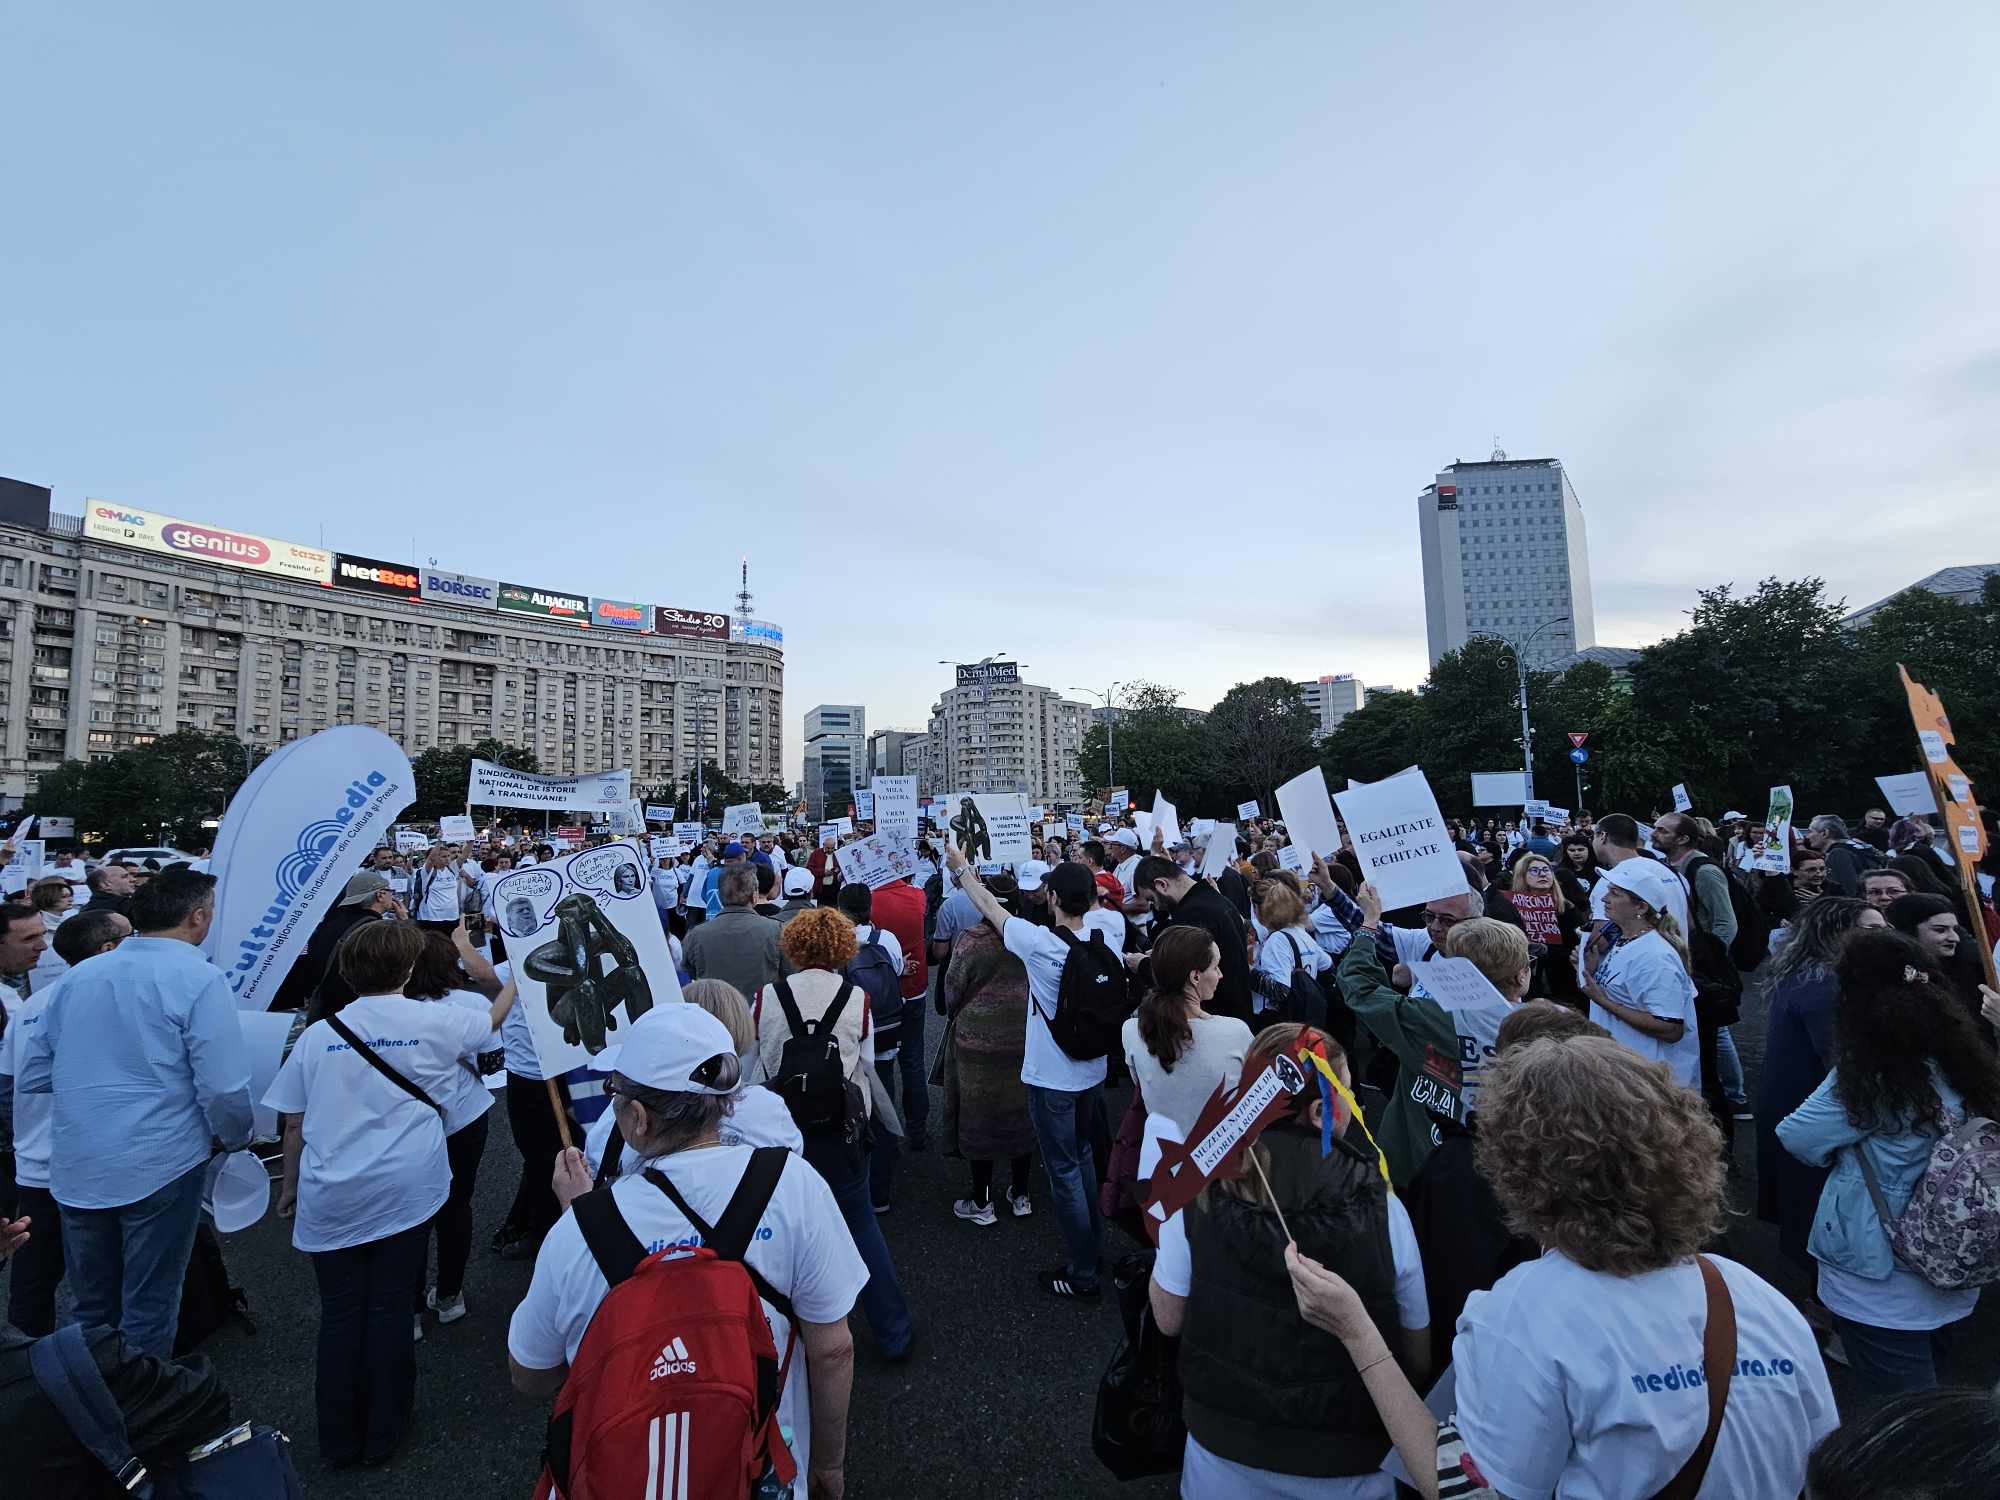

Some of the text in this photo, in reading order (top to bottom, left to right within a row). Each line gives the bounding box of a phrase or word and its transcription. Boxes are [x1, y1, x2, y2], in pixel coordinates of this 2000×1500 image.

[96, 508, 145, 527] eMAG
[172, 528, 260, 559] genius
[289, 547, 326, 562] tazz
[341, 562, 417, 589] NetBet
[428, 576, 492, 600] BORSEC
[531, 592, 586, 612] ALBACHER
[663, 609, 725, 628] Studio 20
[478, 768, 531, 781] SINDICATUL
[498, 791, 567, 802] TRANSILVANIEI
[542, 786, 577, 794] ISTORIE
[338, 839, 350, 857] din
[347, 811, 374, 838] Cultură
[379, 783, 399, 805] Presă
[1359, 817, 1436, 844] EGALITATE
[1371, 843, 1441, 868] ECHITATE
[1194, 1126, 1231, 1162] MUZEUL
[1204, 1136, 1237, 1169] ISTORIE
[650, 1360, 697, 1381] adidas
